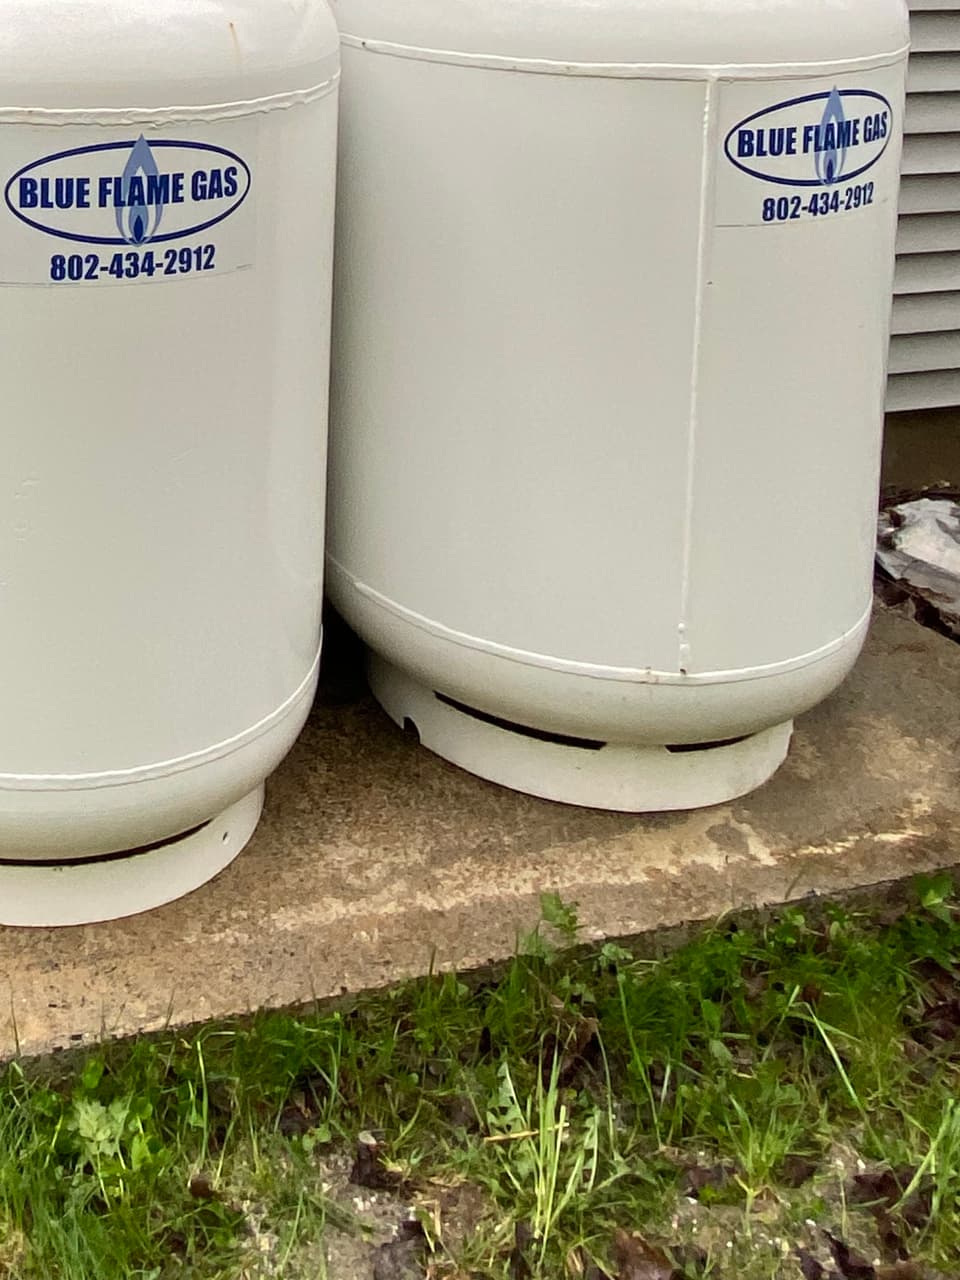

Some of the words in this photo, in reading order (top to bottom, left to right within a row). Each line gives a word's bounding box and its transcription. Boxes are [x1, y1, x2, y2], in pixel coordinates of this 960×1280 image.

[737, 127, 797, 158] BLUE
[802, 119, 860, 154] FLAME
[863, 111, 888, 143] GAS
[19, 177, 90, 209] BLUE
[98, 173, 185, 208] FLAME
[191, 166, 238, 201] GAS
[762, 181, 874, 222] 802-434-2912
[50, 244, 216, 281] 802-434-2912
